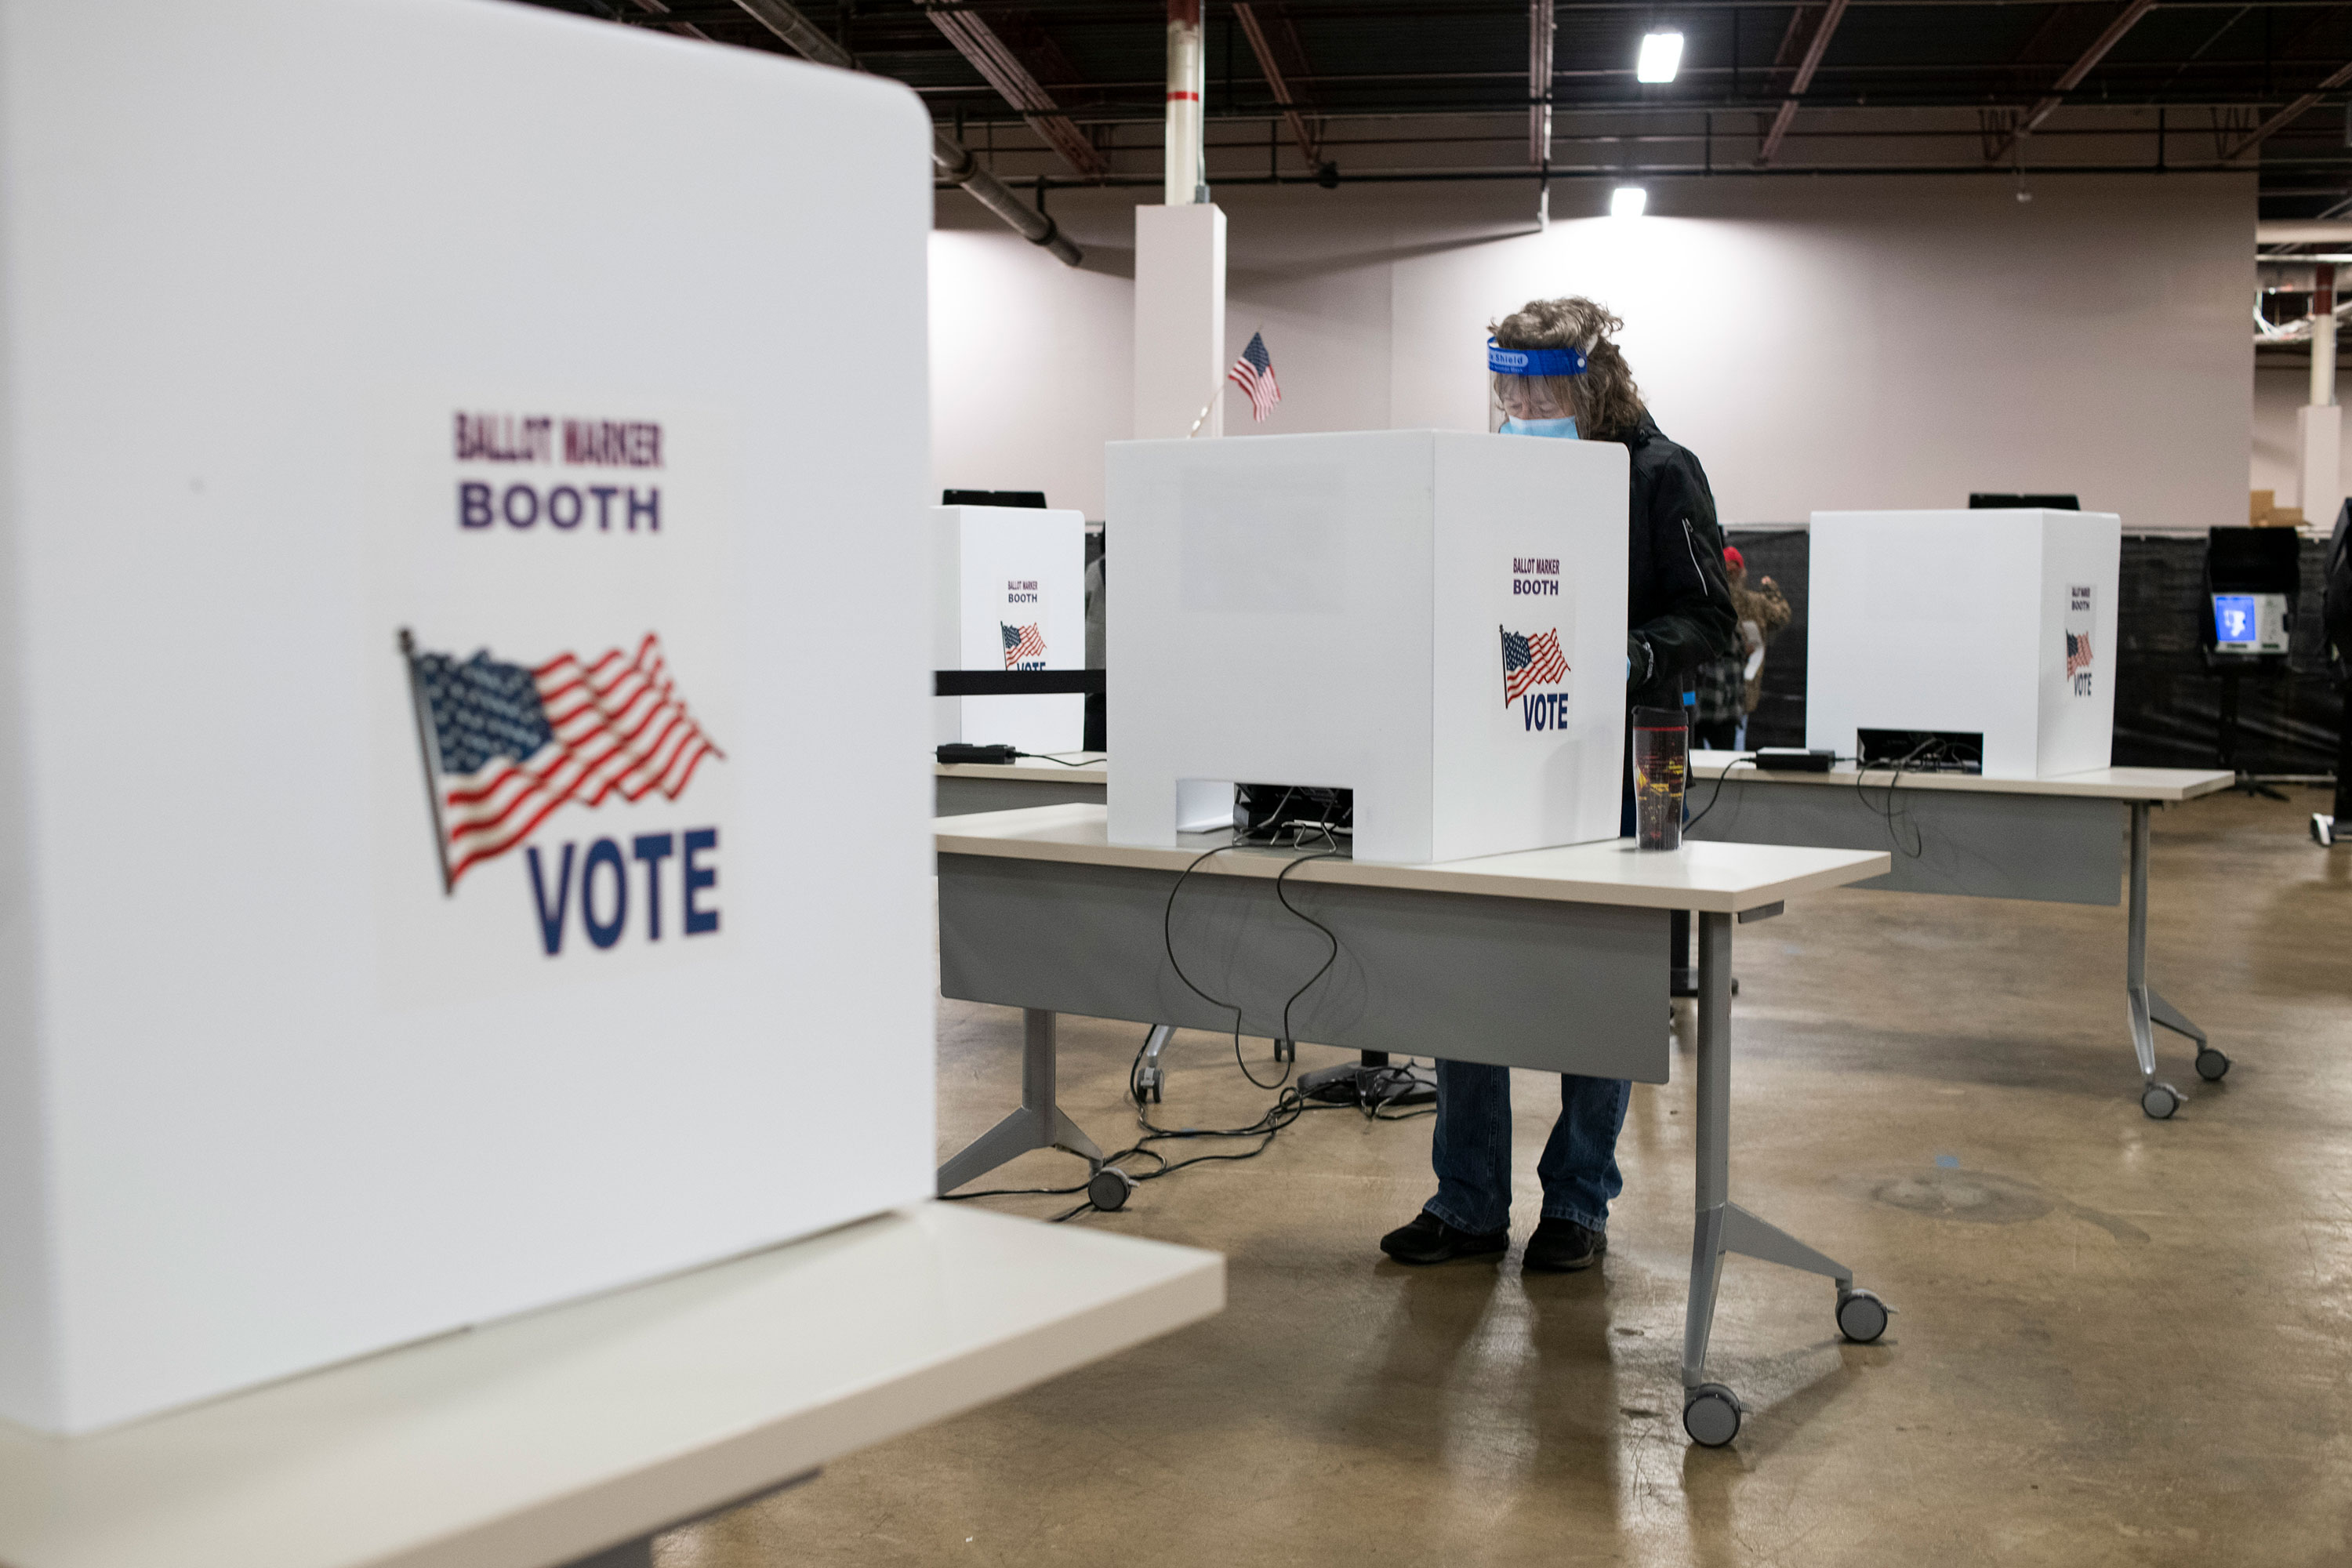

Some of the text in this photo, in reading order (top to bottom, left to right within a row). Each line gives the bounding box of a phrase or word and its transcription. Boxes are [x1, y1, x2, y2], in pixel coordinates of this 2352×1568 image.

[1495, 353, 1523, 365] Shield
[456, 412, 662, 467] BALLOT MARKER
[458, 480, 660, 532] BOOTH
[1513, 557, 1560, 575] BALLOT MARKER
[1008, 593, 1037, 603] BOOTH
[1513, 579, 1559, 595] BOOTH
[2074, 673, 2092, 697] VOTE
[1523, 693, 1569, 731] VOTE
[524, 827, 720, 958] VOTE
